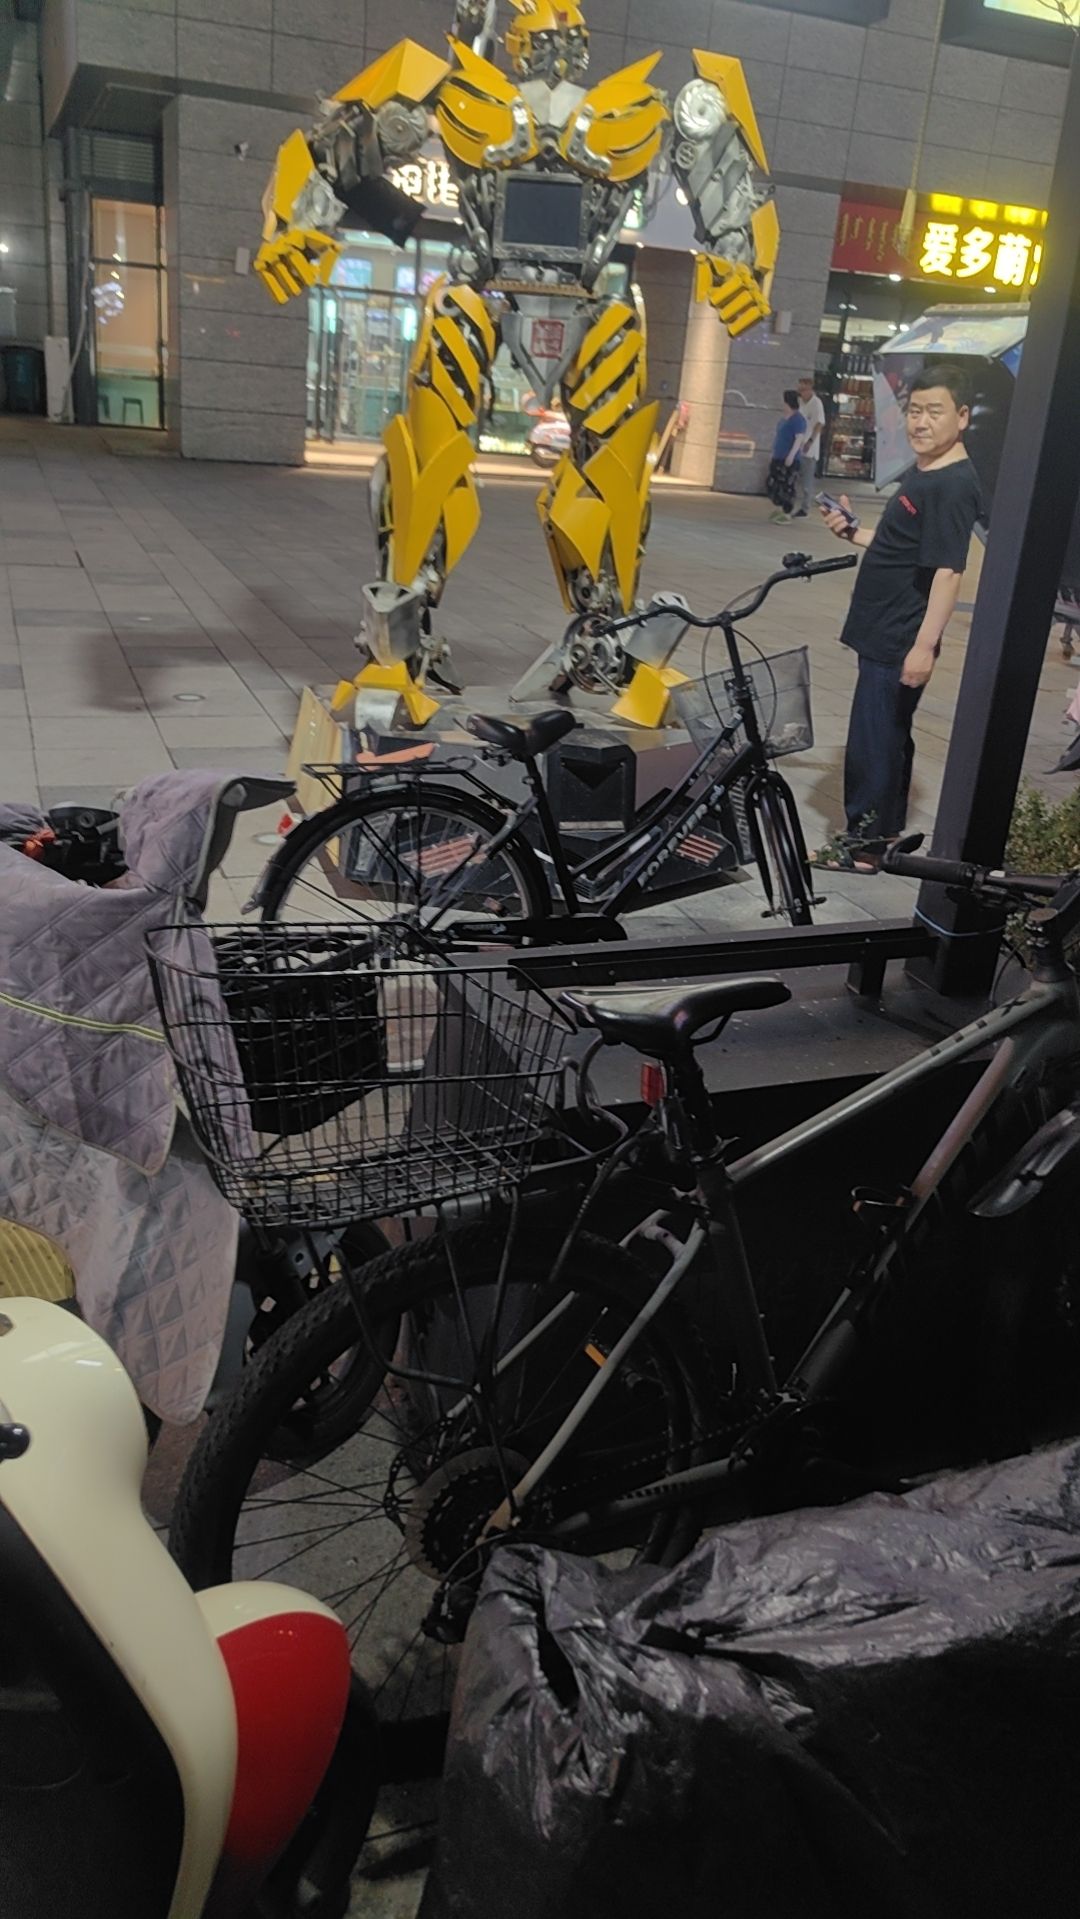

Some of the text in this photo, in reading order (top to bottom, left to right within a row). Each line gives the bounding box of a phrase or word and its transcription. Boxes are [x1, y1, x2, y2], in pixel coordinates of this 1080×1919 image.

[919, 221, 1042, 287] 爱多萌
[637, 803, 708, 888] FOREVER
